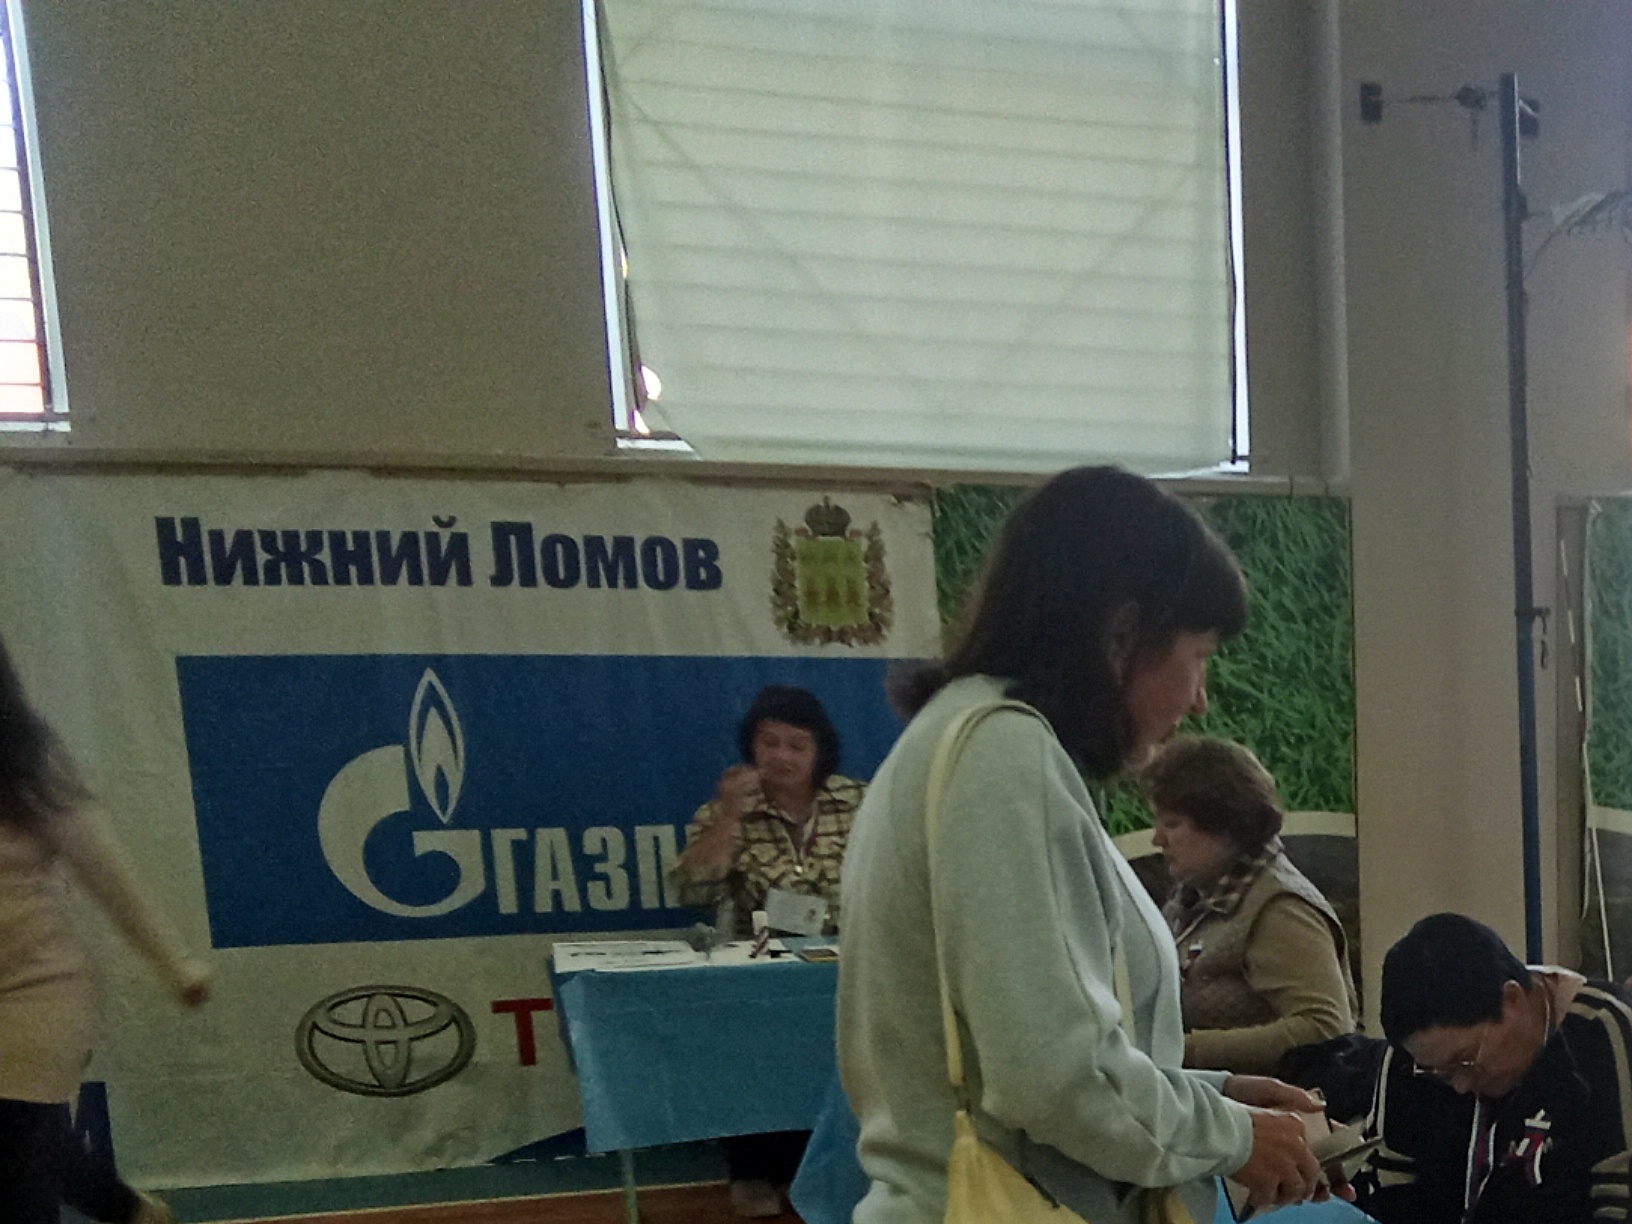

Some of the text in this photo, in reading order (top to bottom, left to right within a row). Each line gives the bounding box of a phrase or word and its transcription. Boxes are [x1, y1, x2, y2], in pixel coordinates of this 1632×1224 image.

[155, 514, 723, 592] Нижний Ломов
[490, 824, 701, 914] ГАЗП
